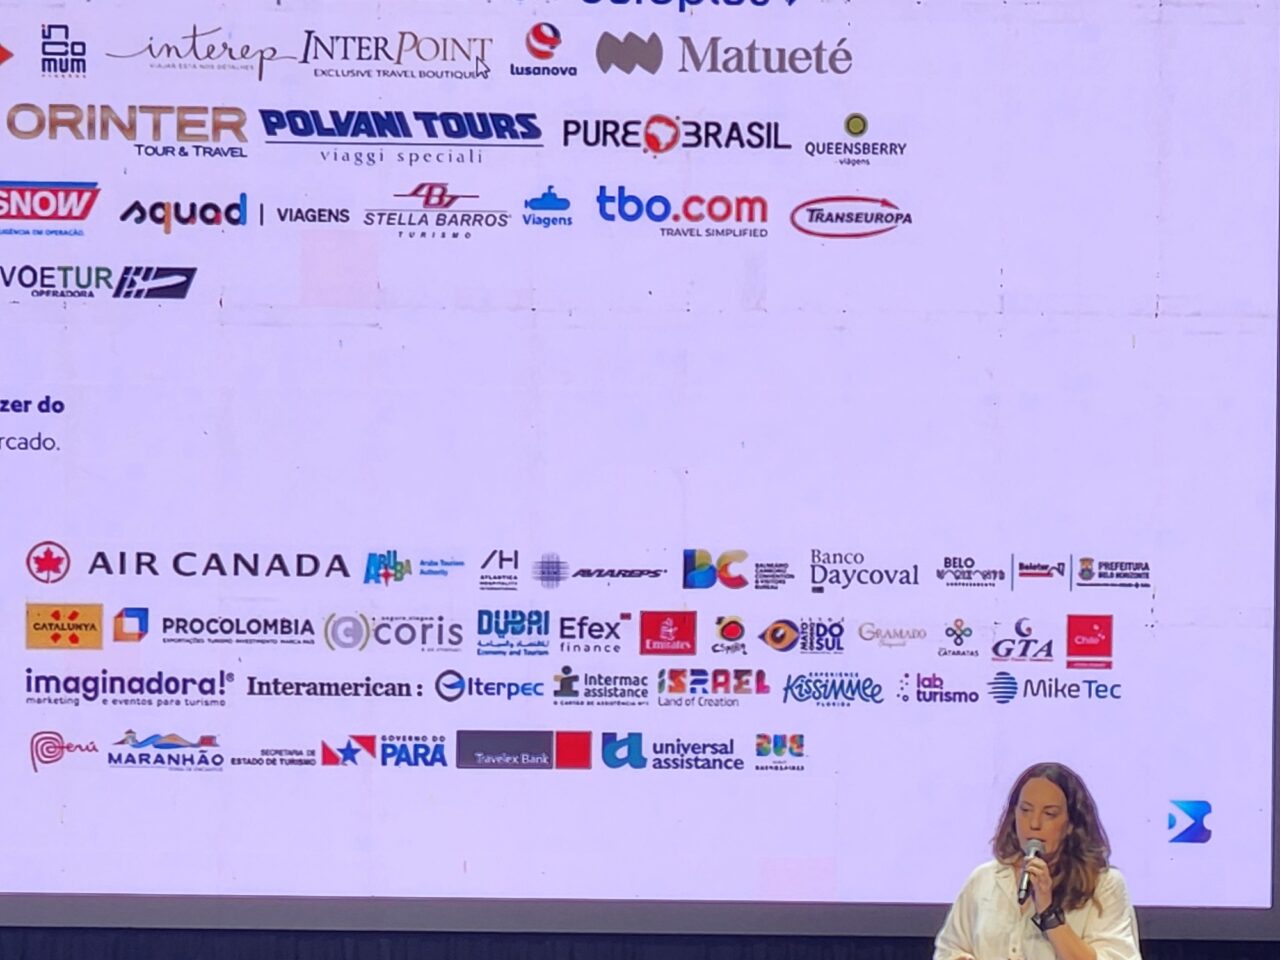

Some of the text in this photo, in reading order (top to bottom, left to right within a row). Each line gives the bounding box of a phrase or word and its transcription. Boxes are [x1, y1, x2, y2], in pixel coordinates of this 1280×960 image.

[106, 24, 297, 81] interep
[678, 36, 853, 74] Matueté
[314, 69, 372, 78] EXCLUSIVE
[376, 69, 416, 78] TRAVEL
[510, 63, 577, 76] lusanova
[6, 103, 249, 143] ORINTER
[259, 109, 543, 140] POLVANI TOURS
[178, 146, 189, 157] &
[192, 145, 248, 158] TRAVEL
[805, 141, 907, 156] QUEENSBERRY
[320, 149, 483, 166] viaggi speciali
[597, 185, 768, 223] tbo.com
[120, 192, 248, 234] squad
[277, 208, 350, 223] VIAGENS
[364, 212, 510, 227] STELLA BARROS
[806, 209, 913, 225] TRANSEUROPA
[523, 214, 573, 228] Viagens
[398, 231, 471, 239] TURISMO
[660, 228, 768, 237] TRAVEL SIMPLIFIED
[0, 265, 113, 289] VOETUR
[31, 290, 94, 298] OPERADORA
[37, 395, 65, 413] do
[810, 549, 864, 564] Banco
[944, 557, 975, 568] BELO
[88, 551, 351, 578] AIR CANADA
[1098, 561, 1150, 571] PREFEITURA
[810, 564, 919, 589] Daycoval
[33, 622, 97, 631] CATALUNYA
[162, 617, 315, 636] PROCOLOMBIA
[374, 615, 463, 645] coris
[477, 609, 550, 638] DUBAI
[559, 616, 621, 639] Efex
[858, 622, 927, 641] GRAMADO
[560, 642, 621, 653] finance
[816, 638, 844, 651] SUL
[991, 638, 1054, 657] GTA
[584, 673, 649, 686] Intermac
[916, 673, 944, 689] lab
[584, 687, 649, 698] assistance
[916, 688, 979, 703] turismo
[26, 697, 79, 707] marketing
[111, 698, 153, 706] eventos
[157, 700, 181, 708] para
[184, 697, 226, 707] turismo
[658, 696, 682, 707] Land
[684, 695, 695, 706] of
[698, 695, 739, 707] Creation
[652, 738, 734, 755] universal
[108, 749, 224, 766] MARANHÃO
[231, 758, 316, 767] ESTADO DE TURISMO
[474, 752, 549, 764] Travelex Bank
[652, 754, 744, 769] assistance
